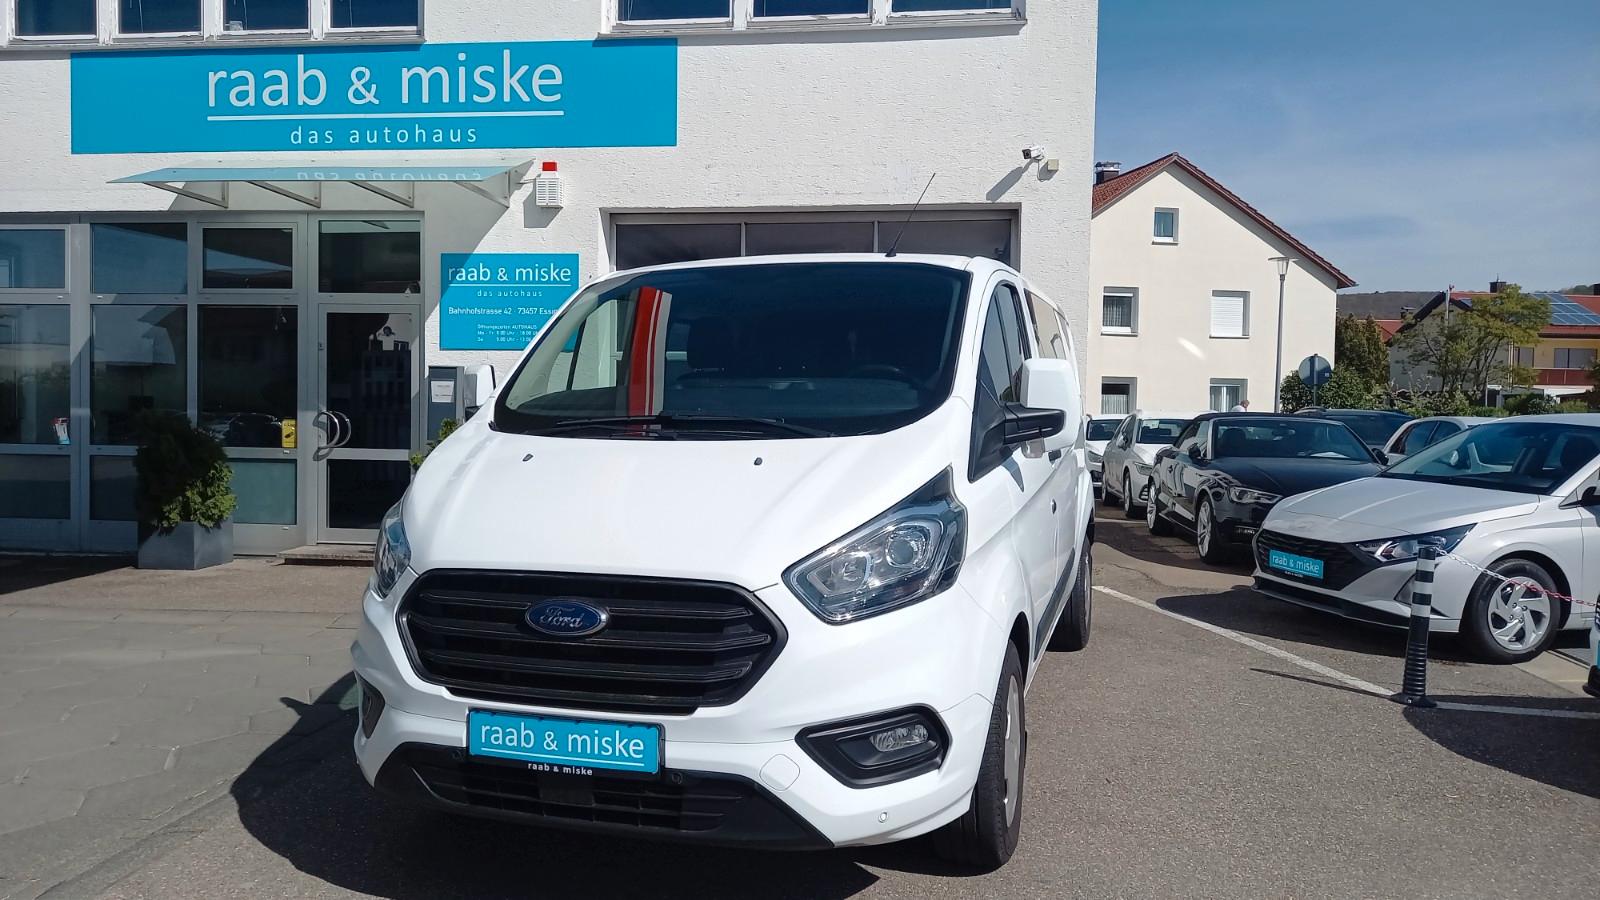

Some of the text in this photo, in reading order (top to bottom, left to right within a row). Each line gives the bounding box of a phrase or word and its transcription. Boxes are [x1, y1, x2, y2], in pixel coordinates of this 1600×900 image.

[208, 49, 563, 107] raab & miske
[290, 124, 477, 145] das autohaus
[448, 262, 572, 282] raab & miske
[477, 289, 543, 297] das autohaus
[448, 306, 502, 315] Bahnhofstrasse
[503, 307, 512, 315] 42
[517, 307, 538, 315] 73457
[1272, 555, 1320, 573] raab & miske
[539, 606, 586, 629] Ford
[480, 721, 645, 759] raab & miske
[527, 762, 550, 772] raab
[562, 766, 593, 776] miske
